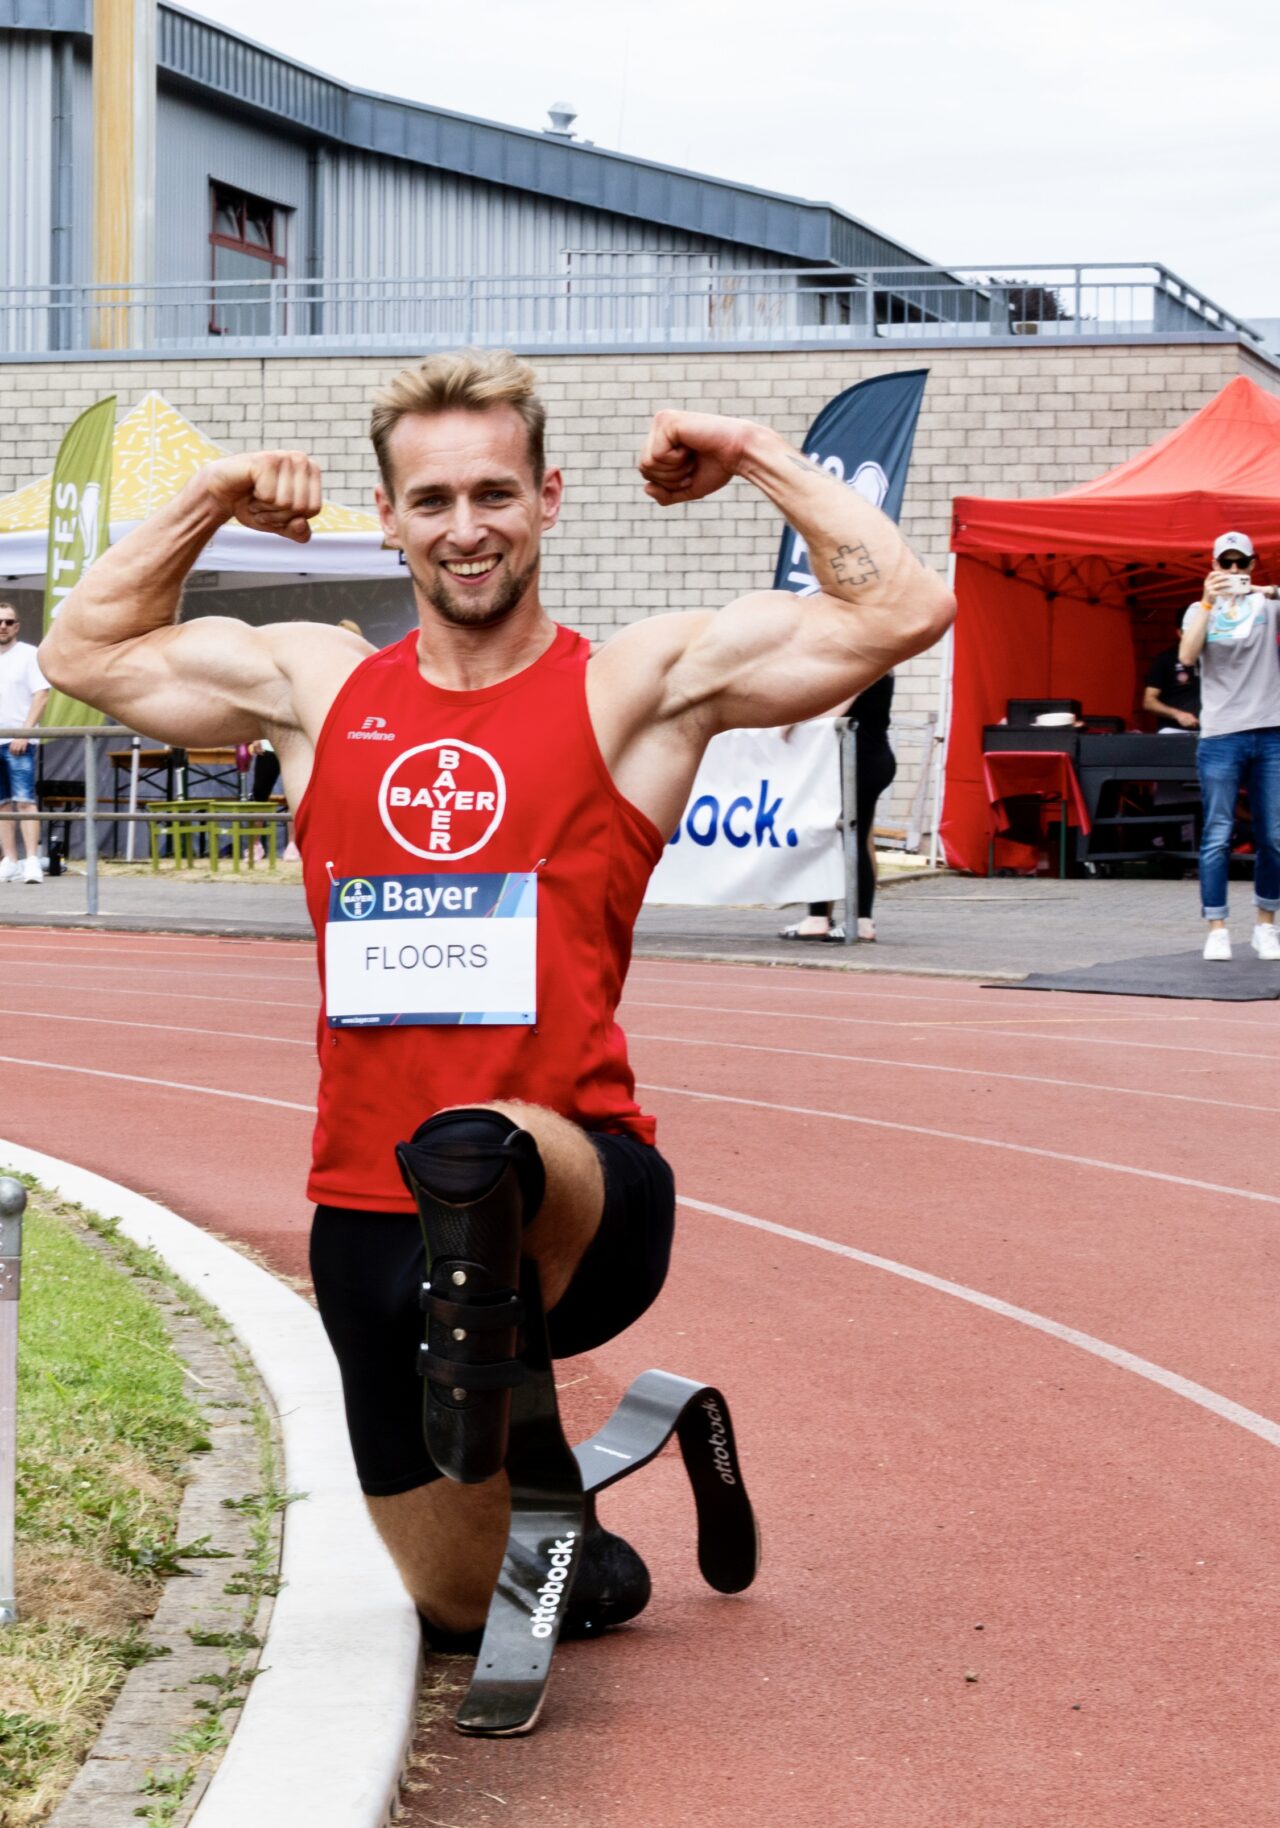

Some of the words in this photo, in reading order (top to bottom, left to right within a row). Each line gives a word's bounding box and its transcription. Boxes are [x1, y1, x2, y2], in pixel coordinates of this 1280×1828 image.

[346, 730, 396, 741] newline
[390, 786, 496, 811] BAYER
[429, 749, 460, 851] BAYER
[670, 779, 799, 849] ock.
[383, 881, 478, 916] Bayer
[365, 944, 489, 970] FLOORS
[531, 1531, 576, 1638] ottobock.
